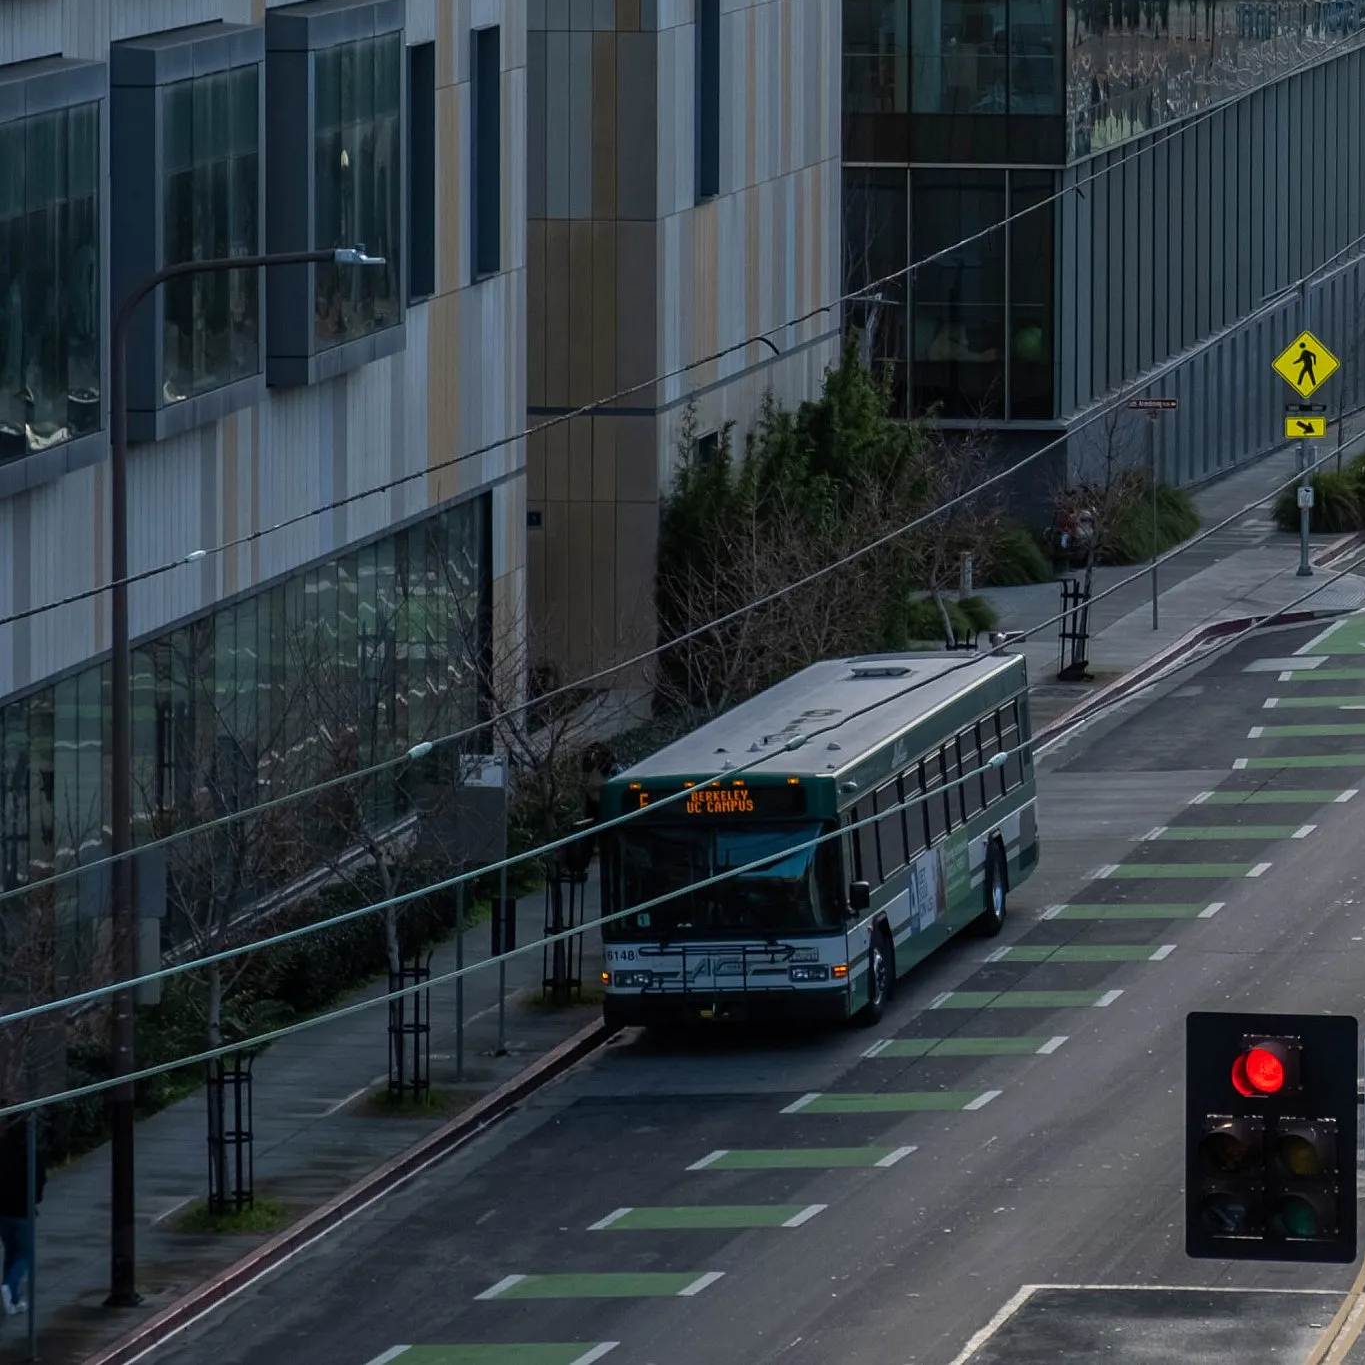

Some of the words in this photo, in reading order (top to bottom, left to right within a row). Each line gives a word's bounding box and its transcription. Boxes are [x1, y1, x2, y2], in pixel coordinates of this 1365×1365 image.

[691, 790, 748, 801] BERKELEY
[687, 801, 702, 813] UC
[707, 800, 754, 812] CAMPUS
[606, 952, 634, 962] 6148
